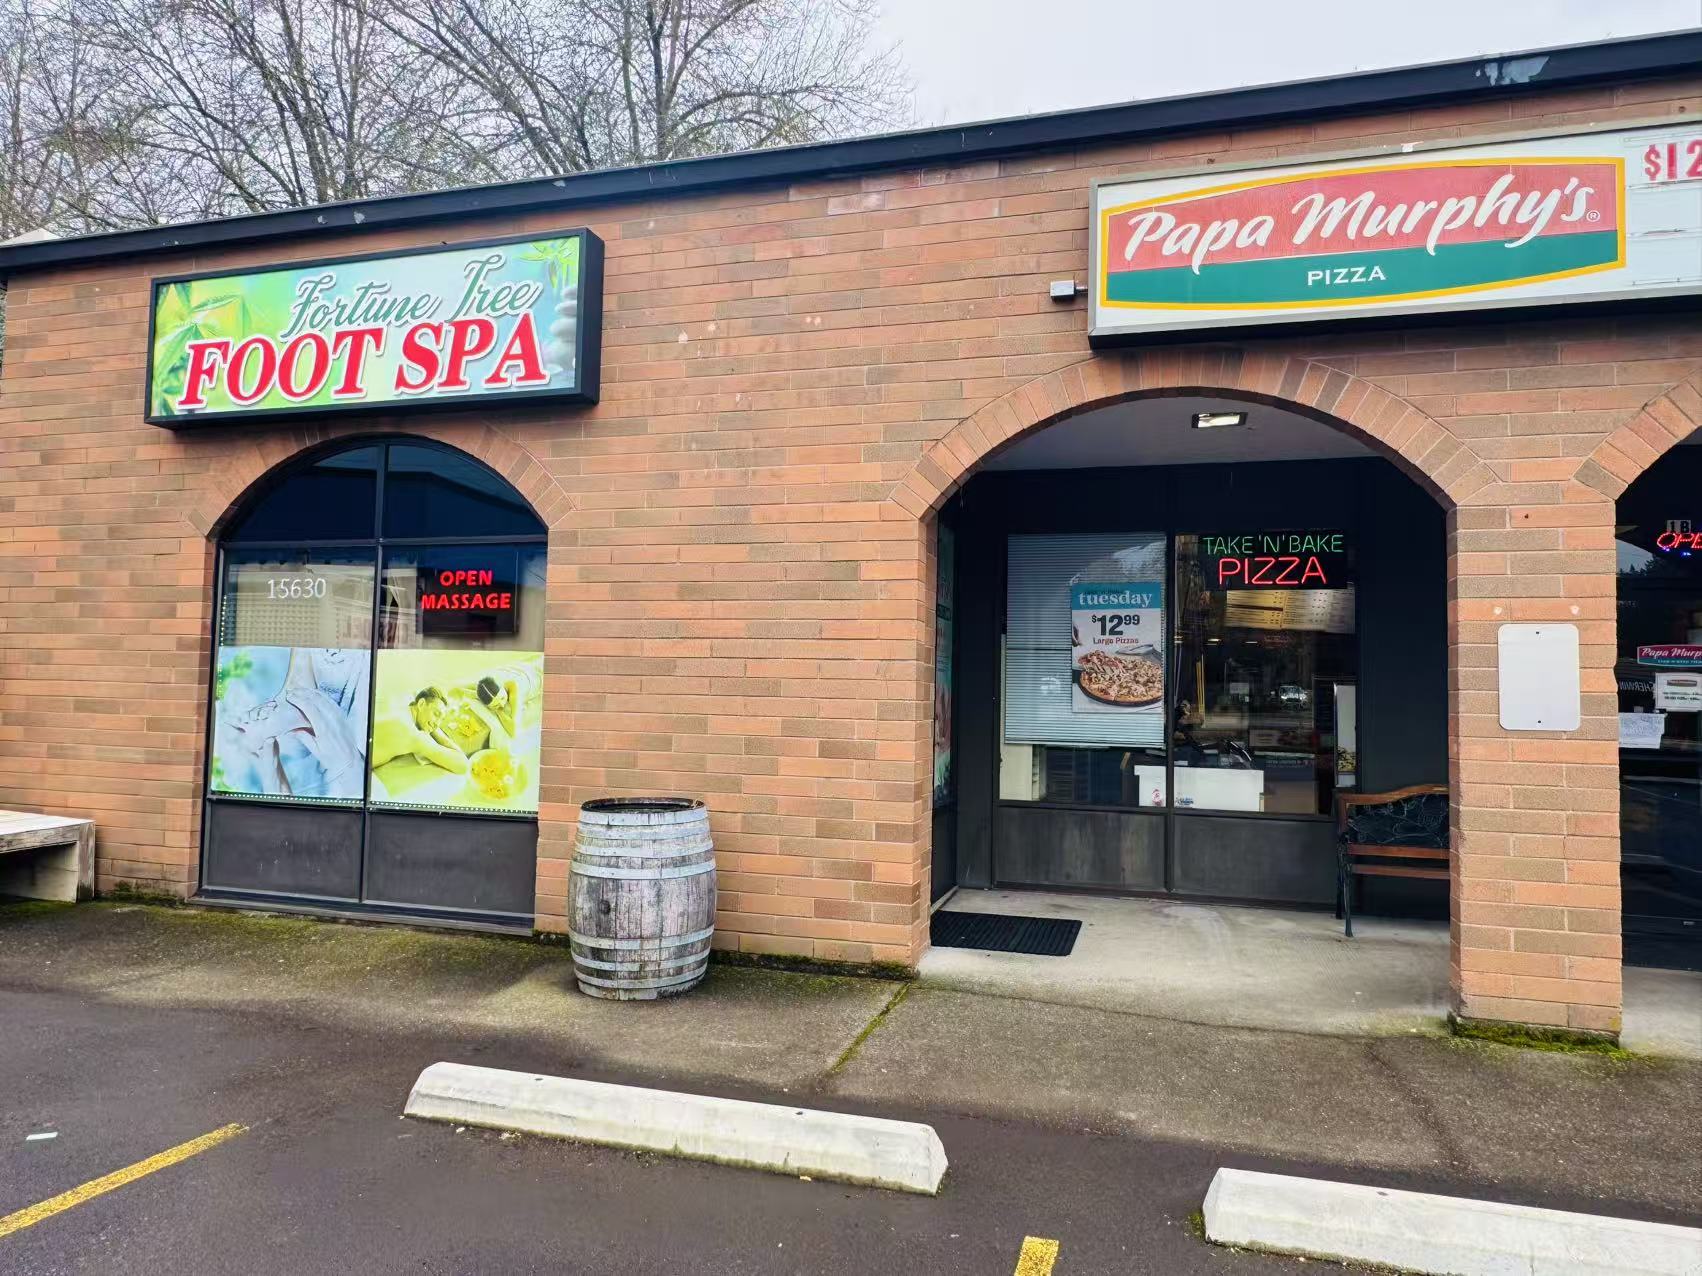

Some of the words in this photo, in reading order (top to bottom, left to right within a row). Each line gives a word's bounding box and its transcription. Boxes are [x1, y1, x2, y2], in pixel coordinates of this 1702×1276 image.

[1123, 210, 1273, 275] Papa
[1307, 264, 1387, 287] PIZZA
[280, 274, 440, 340] Fortune
[447, 254, 543, 324] Tree
[177, 326, 385, 408] FOOT
[394, 312, 550, 393] SPA
[1202, 536, 1254, 555] TAKE
[1289, 534, 1344, 553] BAKE
[439, 570, 493, 587] OPEN
[1219, 556, 1328, 585] PIZZA
[266, 578, 326, 599] 15630
[1078, 590, 1152, 607] tuesday
[420, 593, 512, 610] MASSAGE
[1093, 637, 1114, 645] Large
[1641, 648, 1669, 659] Papa
